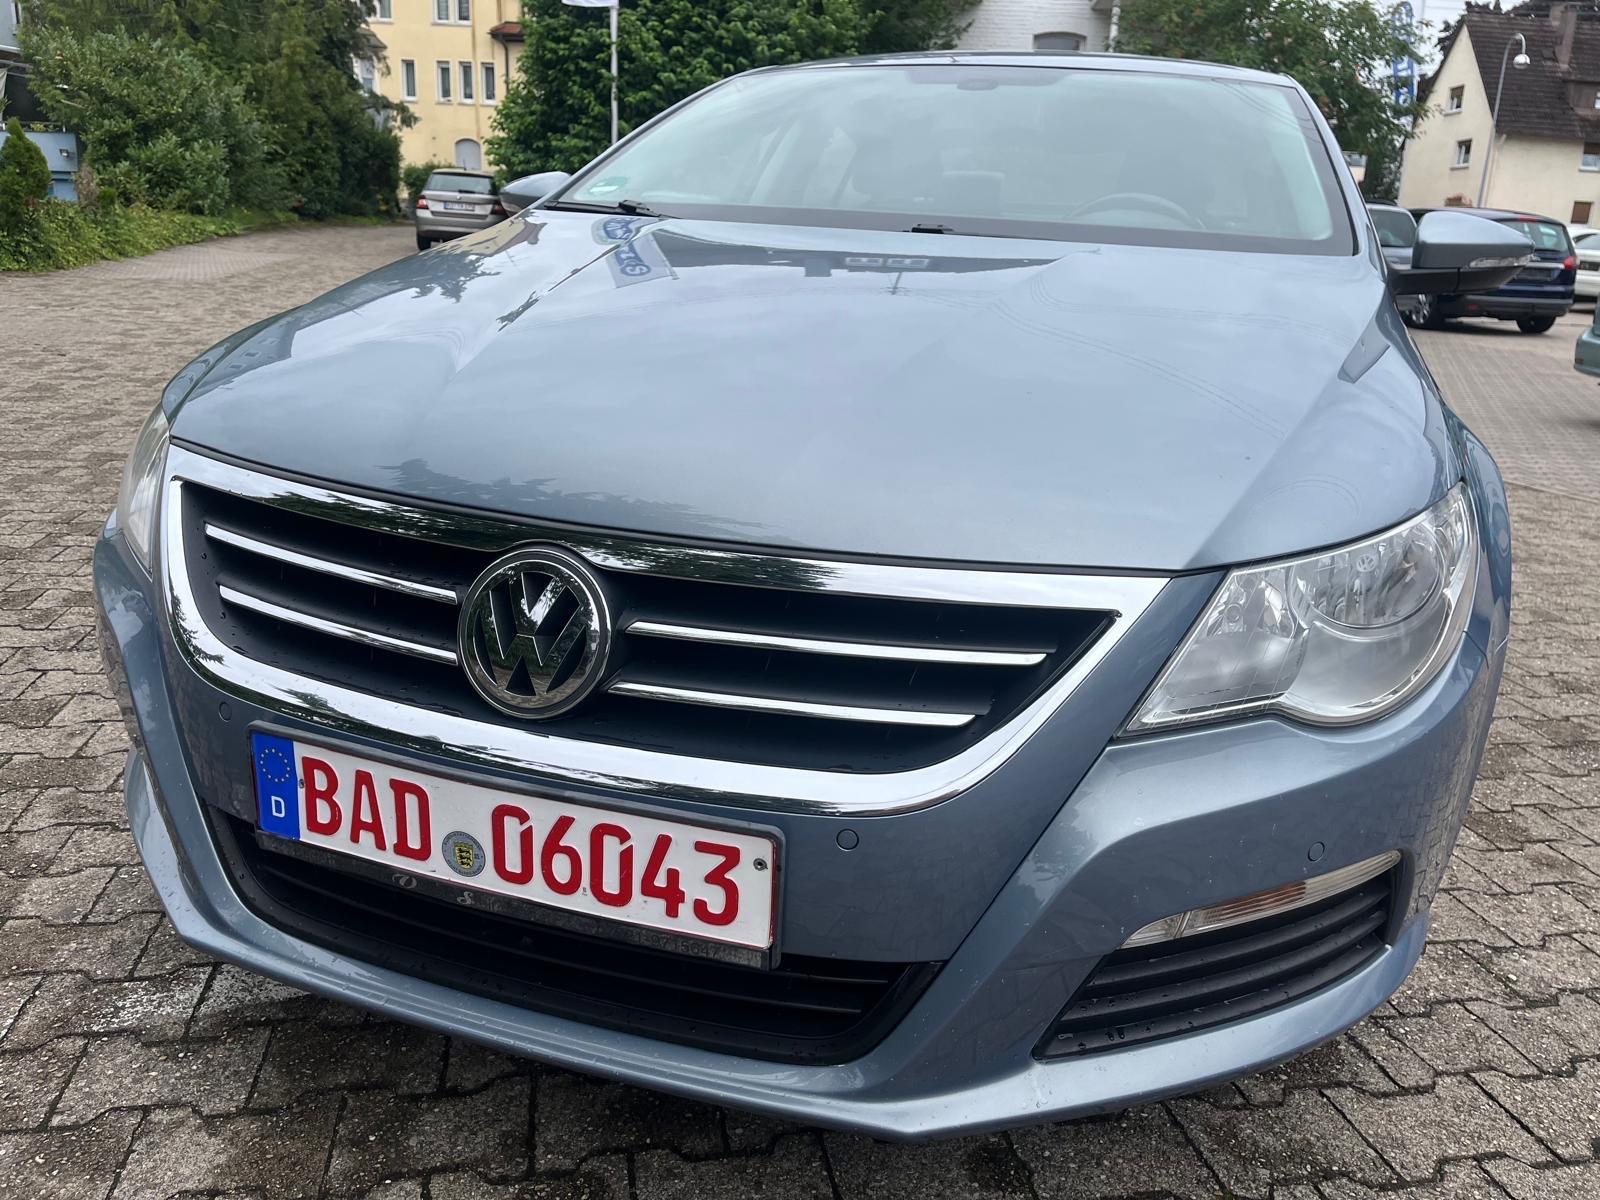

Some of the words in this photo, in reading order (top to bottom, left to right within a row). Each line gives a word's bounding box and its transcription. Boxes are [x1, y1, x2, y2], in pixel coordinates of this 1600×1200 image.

[464, 556, 602, 709] VW
[271, 796, 285, 818] D
[301, 755, 432, 862] BAD
[491, 803, 741, 926] 06043
